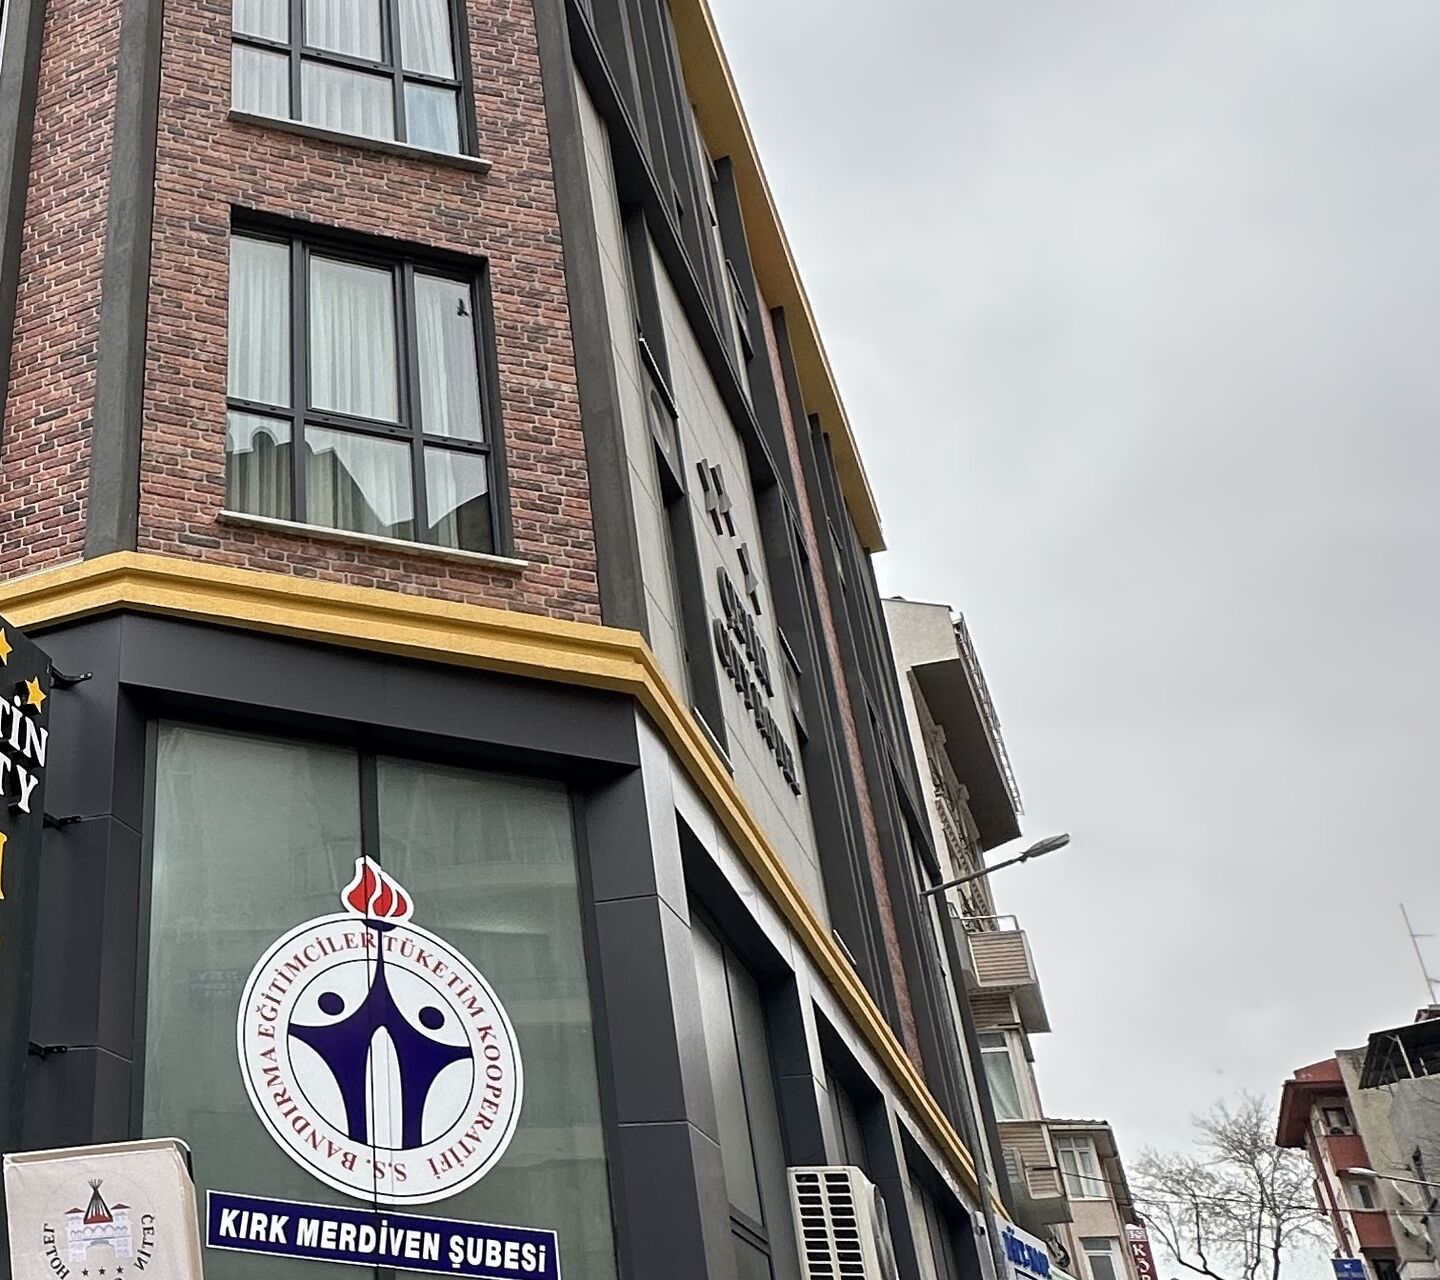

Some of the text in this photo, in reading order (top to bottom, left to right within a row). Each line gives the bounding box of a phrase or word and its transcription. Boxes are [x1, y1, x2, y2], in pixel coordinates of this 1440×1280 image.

[255, 931, 377, 1040] EĞİTİMCİLER
[383, 933, 485, 1018] TÜKETİM
[259, 1046, 358, 1172] BANDIRMA
[427, 1024, 503, 1180] KOOPERATİFİ
[219, 1208, 547, 1273] KIRK MERDİVEN ŞUBESİ
